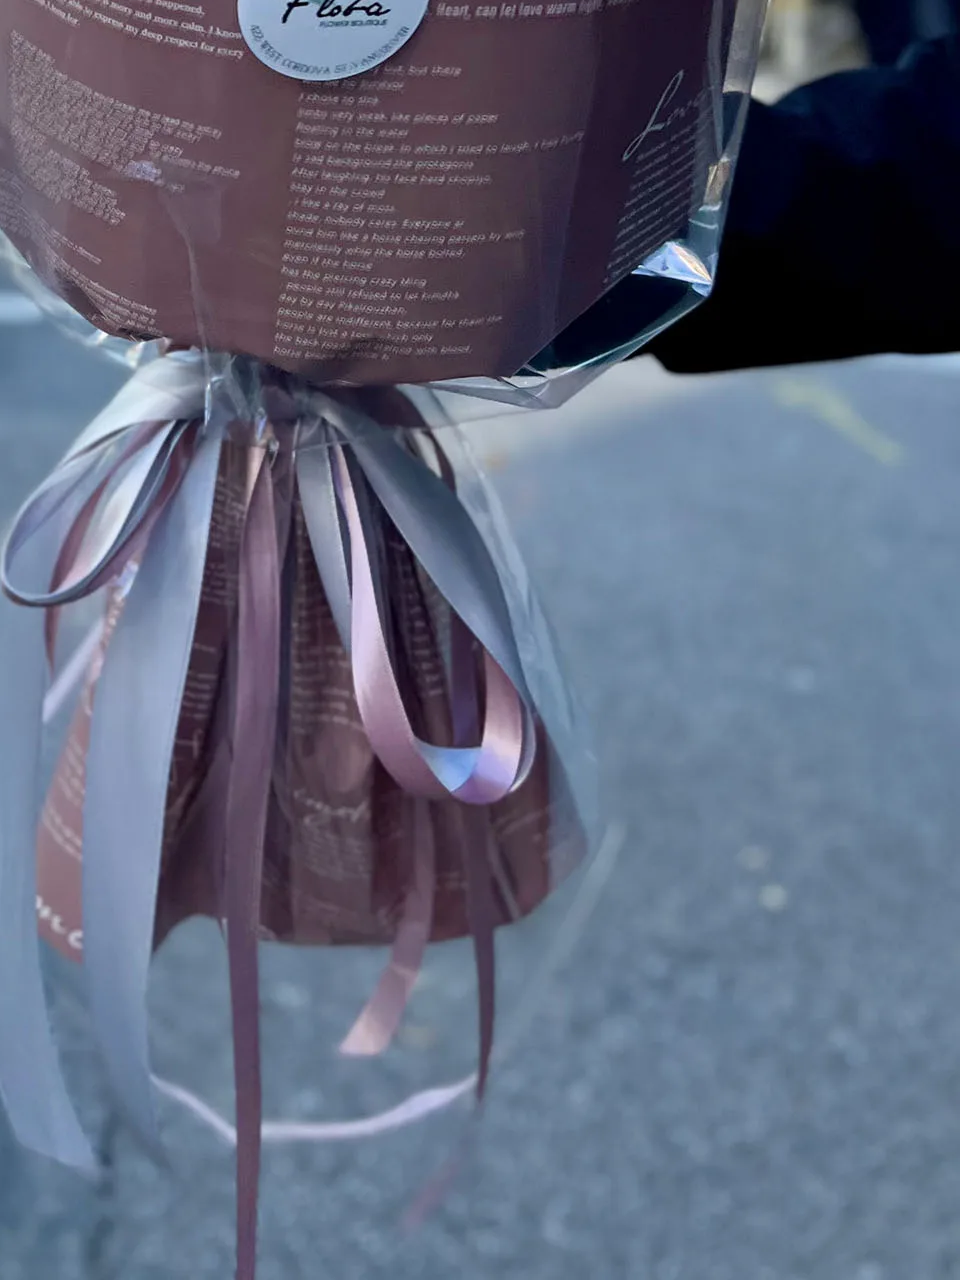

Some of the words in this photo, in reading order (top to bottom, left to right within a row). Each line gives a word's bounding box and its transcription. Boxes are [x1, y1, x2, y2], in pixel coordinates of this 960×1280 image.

[474, 4, 497, 19] can
[499, 2, 518, 19] let
[518, 1, 544, 17] love
[545, 1, 577, 16] warm
[135, 10, 152, 21] and
[153, 15, 179, 28] more
[125, 24, 139, 36] my
[140, 28, 163, 42] deep
[164, 35, 199, 48] respect
[200, 41, 215, 53] for
[450, 112, 467, 126] of
[465, 112, 500, 126] paper
[356, 126, 376, 138] the
[485, 143, 499, 156] to
[291, 166, 320, 178] After
[393, 172, 419, 185] face
[329, 185, 349, 197] the
[352, 202, 365, 213] of
[402, 218, 452, 231] Everyone
[315, 228, 338, 239] him
[371, 232, 402, 244] horse
[488, 231, 501, 242] by
[344, 245, 372, 258] whip
[374, 247, 394, 258] the
[395, 247, 426, 259] horse
[320, 257, 341, 269] the
[341, 260, 374, 272] horse
[280, 264, 300, 277] has
[301, 269, 322, 280] the
[321, 271, 368, 287] piercing
[368, 277, 398, 289] crazy
[325, 286, 346, 297] still
[346, 287, 388, 301] refused
[389, 291, 402, 301] to
[299, 295, 314, 308] by
[316, 313, 334, 323] are
[396, 319, 438, 330] because
[440, 317, 457, 329] for
[274, 332, 293, 343] the
[412, 332, 434, 344] only
